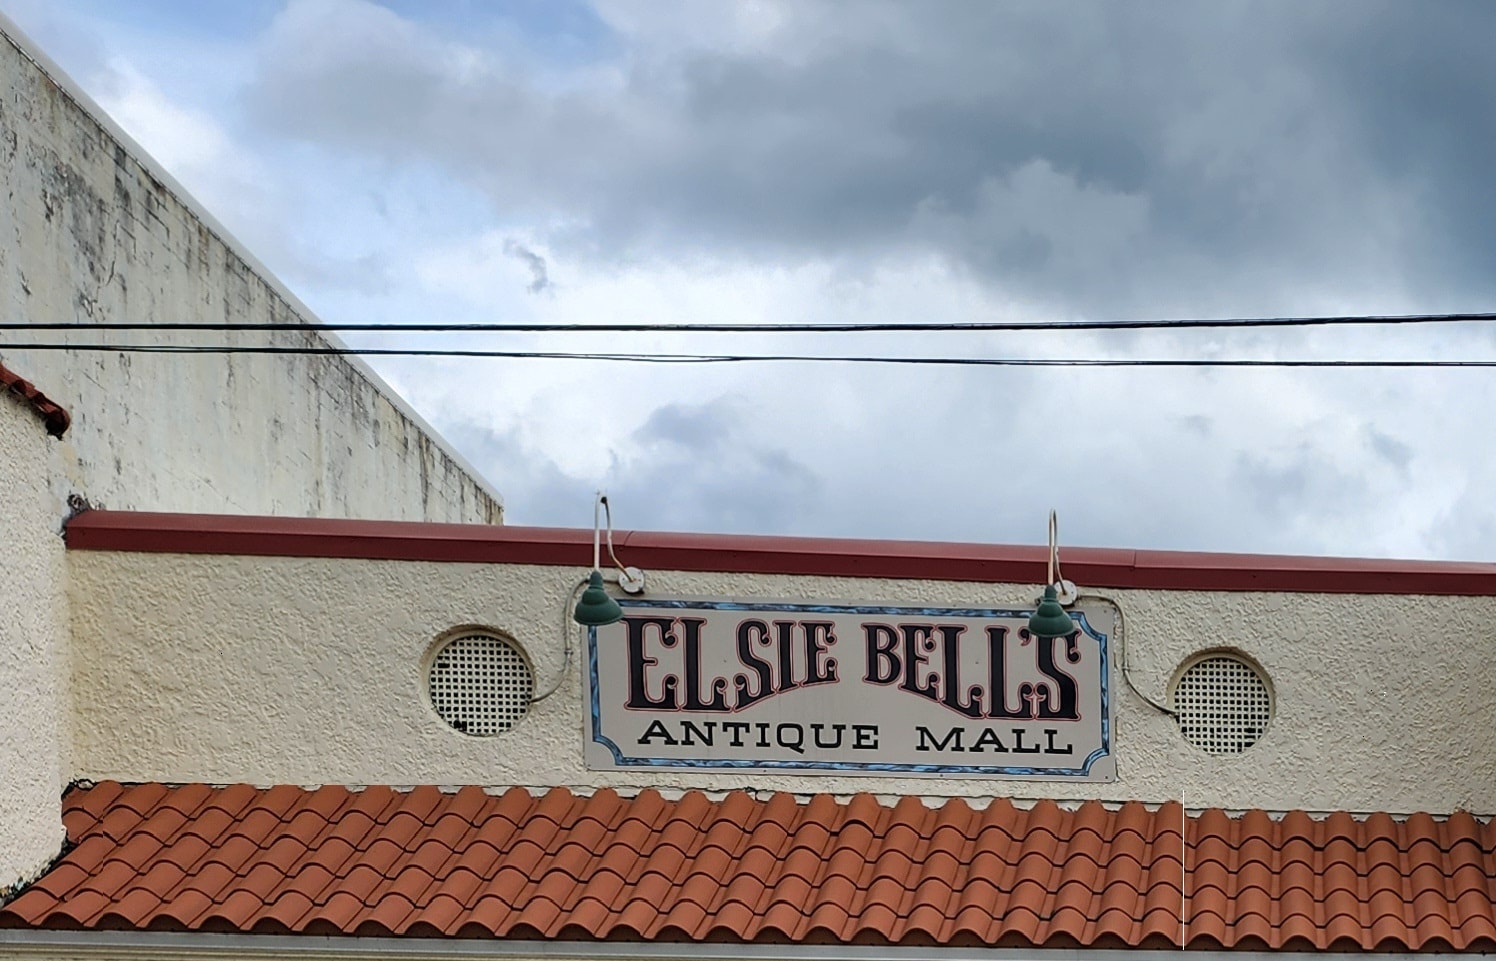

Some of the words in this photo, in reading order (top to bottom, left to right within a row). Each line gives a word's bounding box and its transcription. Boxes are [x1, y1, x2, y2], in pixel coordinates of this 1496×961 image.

[624, 615, 838, 713] ELSIE
[862, 623, 1081, 721] BELL'S
[637, 719, 880, 754] ANTIQUE
[915, 726, 1073, 755] MALL
